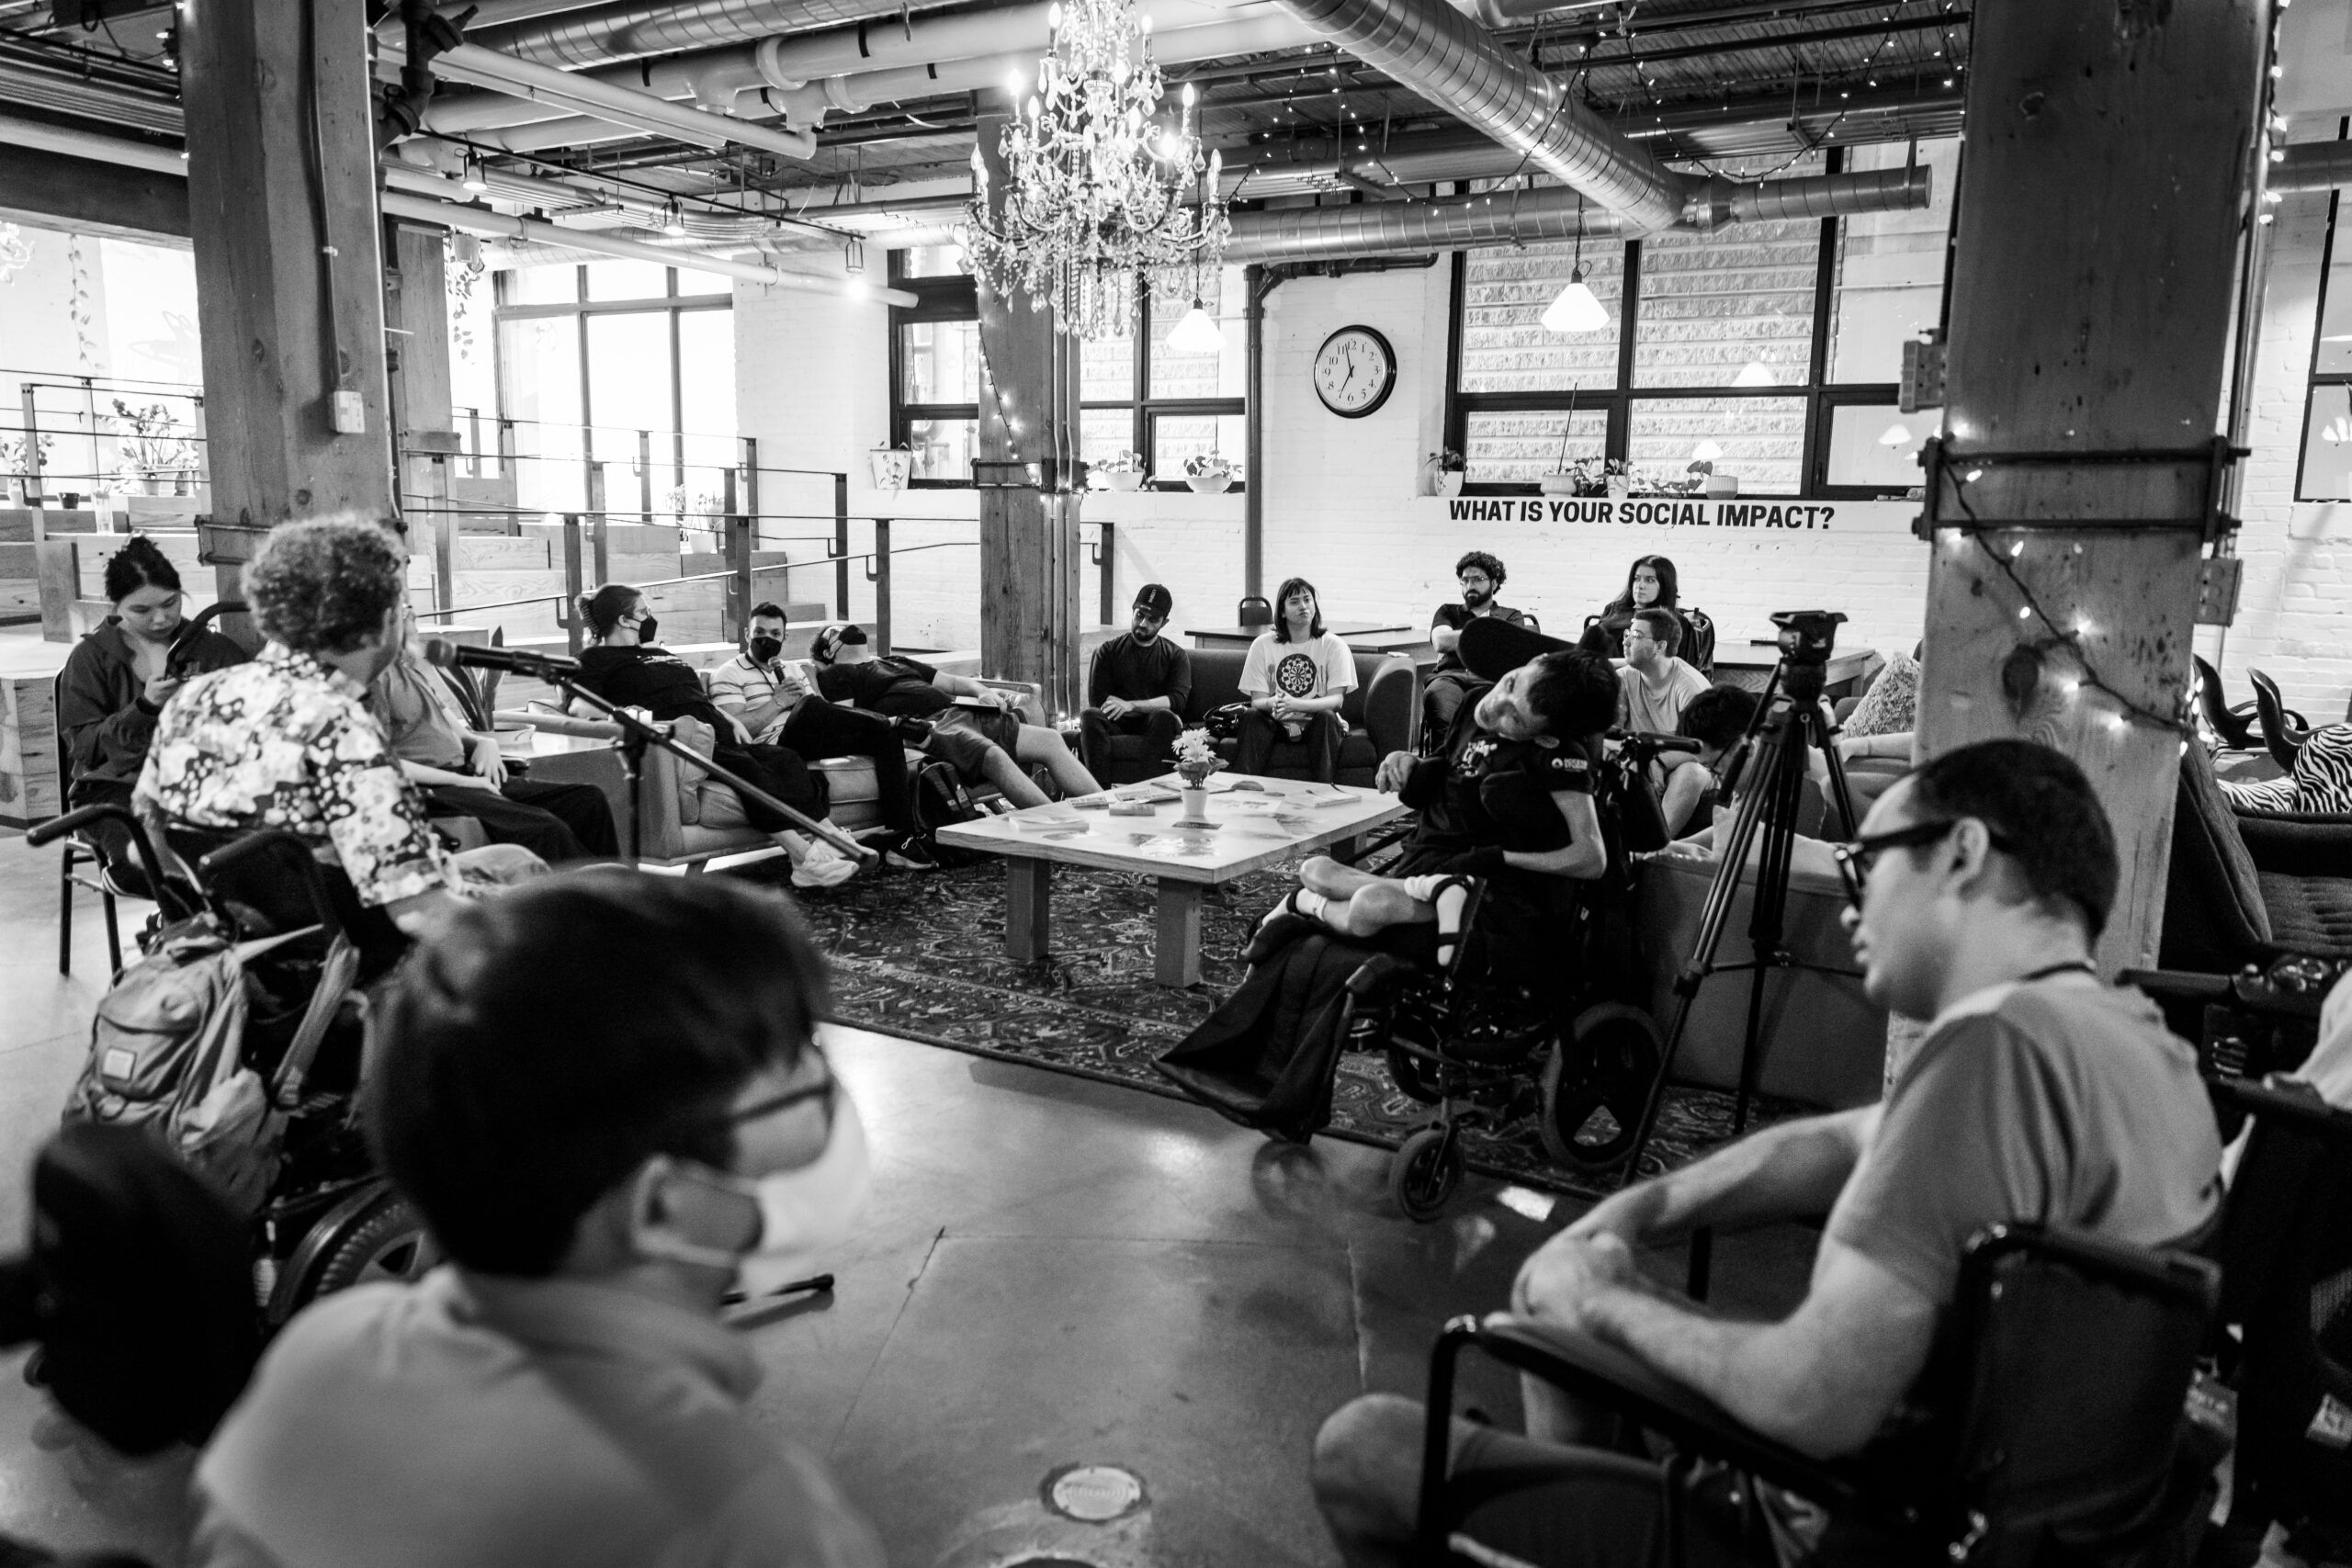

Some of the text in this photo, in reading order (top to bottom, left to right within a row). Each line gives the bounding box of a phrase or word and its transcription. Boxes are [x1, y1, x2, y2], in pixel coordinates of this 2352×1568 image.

[1337, 345, 1345, 355] 11
[1347, 340, 1357, 351] 12
[1329, 355, 1339, 366] 10
[1368, 351, 1374, 361] 2
[1324, 367, 1331, 377] 9
[1374, 366, 1379, 375] 3
[1328, 381, 1334, 390] 8
[1368, 378, 1374, 388] 4
[1337, 389, 1342, 399] 7
[1347, 392, 1354, 402] 6
[1361, 389, 1367, 400] 5
[1450, 500, 1835, 530] WHAT IS YOUR SOCIAL IMPACT?
